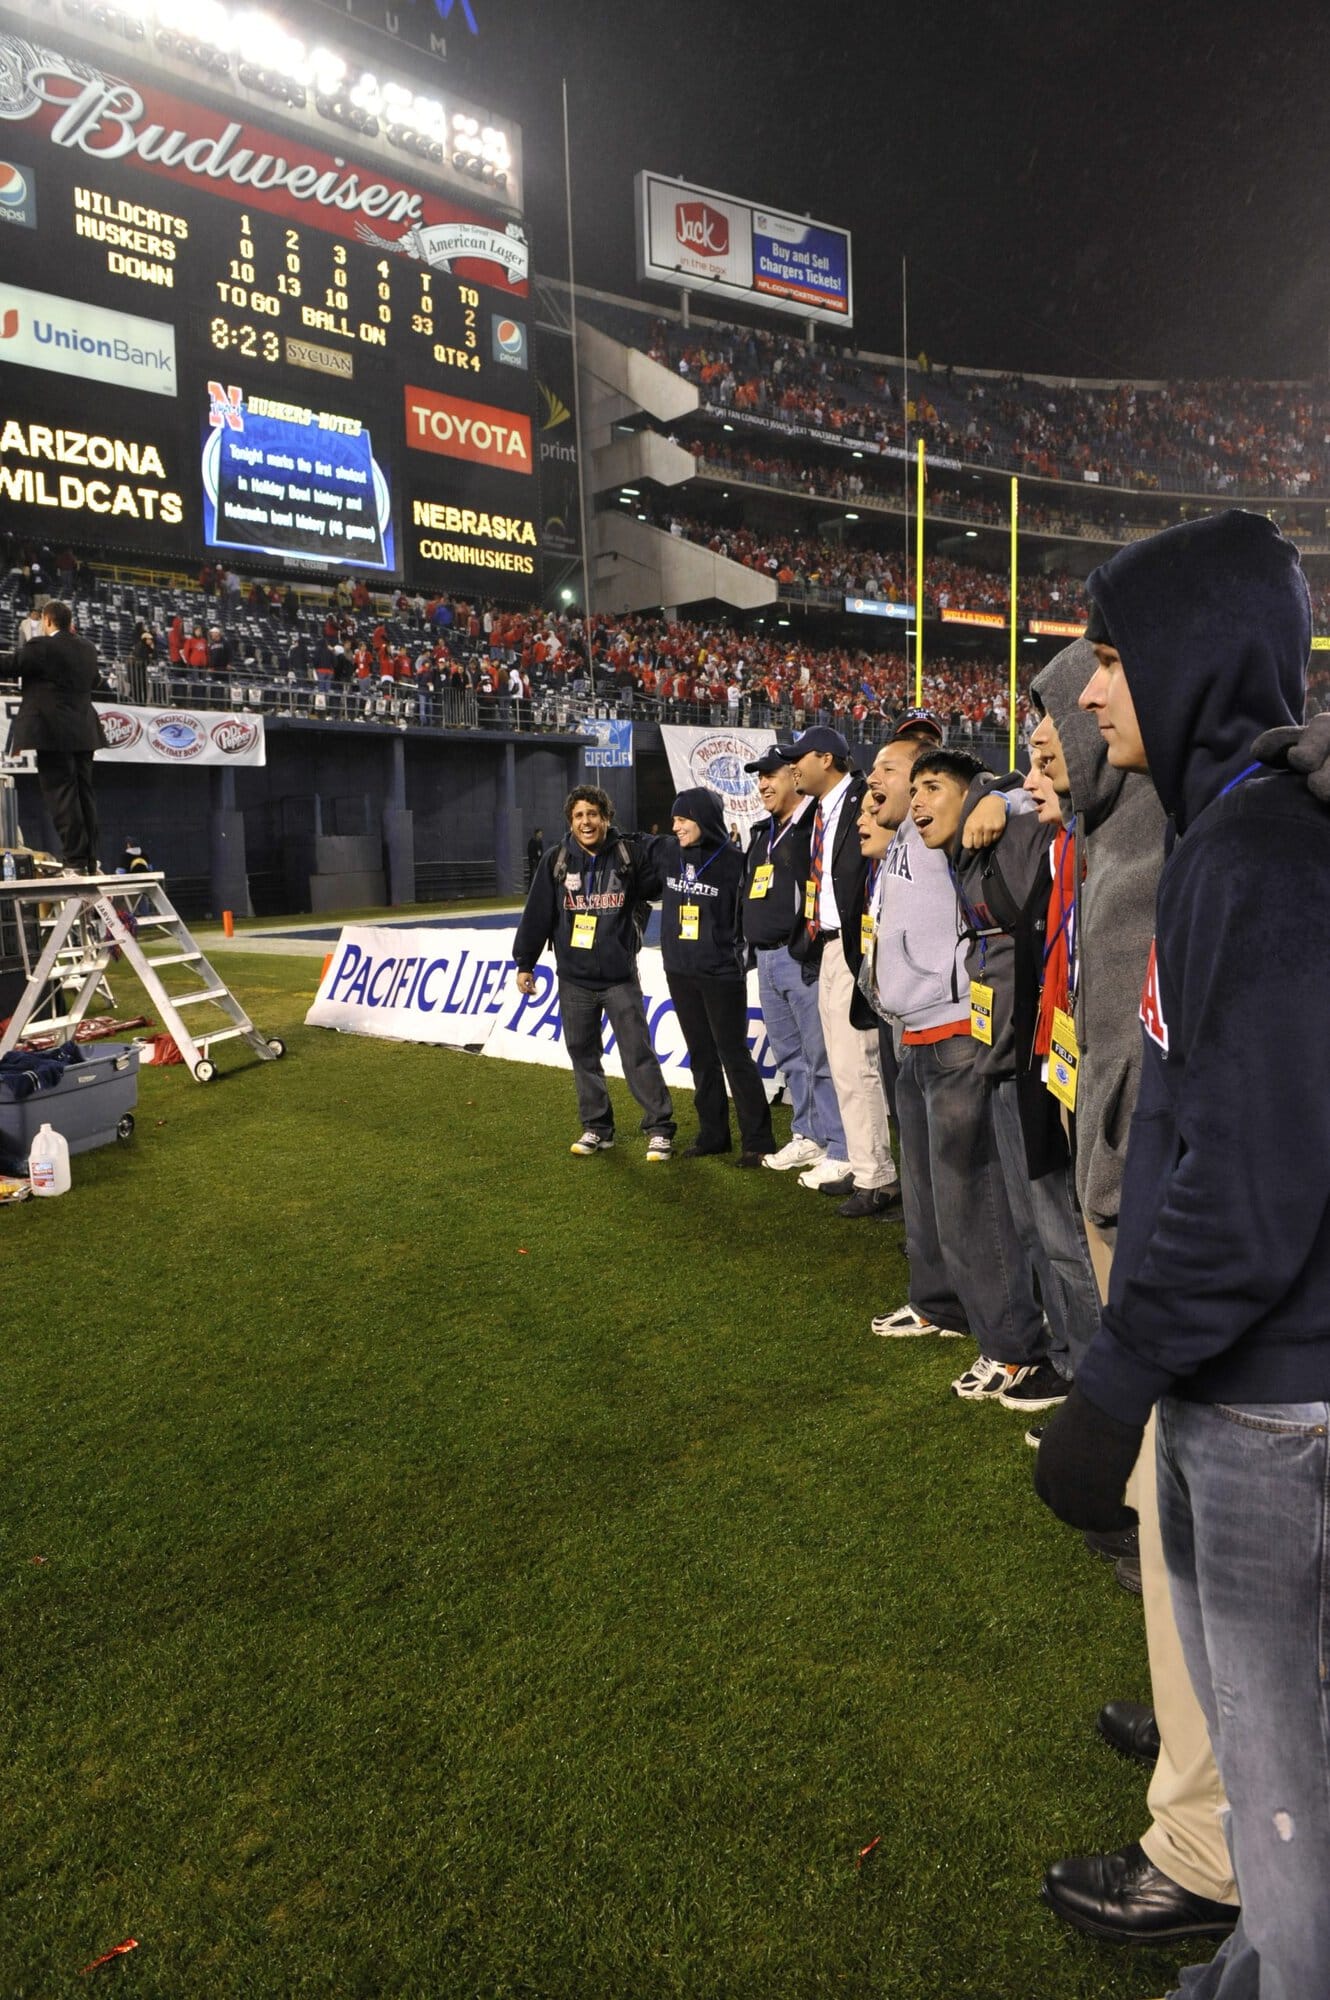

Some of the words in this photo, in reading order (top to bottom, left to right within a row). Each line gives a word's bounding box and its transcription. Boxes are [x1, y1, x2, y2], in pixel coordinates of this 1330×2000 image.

[27, 67, 422, 222] Budweiser
[429, 234, 486, 255] American
[490, 240, 525, 265] Lager
[677, 207, 728, 252] Jack
[74, 187, 188, 239] WILDCATS
[240, 239, 254, 259] 0
[286, 253, 300, 273] 0
[334, 269, 347, 287] 0
[378, 282, 390, 300] 0
[421, 296, 433, 313] 0
[465, 310, 476, 327] 2
[241, 214, 251, 235] 1
[285, 229, 299, 250] 2
[333, 245, 346, 265] 3
[377, 260, 390, 278] 4
[420, 273, 432, 291] T
[458, 285, 479, 307] TO
[760, 256, 803, 280] Chargers
[805, 268, 841, 290] Tickets!
[772, 242, 790, 262] Buy
[792, 251, 810, 265] and
[812, 254, 829, 270] Sell
[76, 214, 176, 260] HUSKERS
[229, 260, 254, 283] 10
[277, 274, 301, 297] 13
[326, 288, 348, 310] 10
[379, 305, 391, 323] 0
[412, 314, 433, 335] 33
[465, 331, 476, 348] 3
[108, 251, 174, 288] DOWN
[217, 282, 247, 308] TO
[251, 292, 280, 317] GO
[302, 306, 355, 338] BALL
[360, 323, 386, 346] ON
[433, 344, 468, 369] QTR
[470, 355, 481, 372] 4
[33, 320, 172, 371] UnionBank
[211, 318, 279, 361] 8:23
[288, 344, 351, 371] SYCUAN
[0, 420, 166, 478] ARIZONA
[412, 406, 527, 459] TOYOTA
[229, 443, 263, 466] Tonight
[297, 457, 312, 473] the
[0, 466, 183, 523] WILDCATS
[413, 500, 537, 546] NEBRASKA
[419, 539, 534, 574] CORNHUSKERS
[107, 717, 123, 730] Dr
[326, 944, 449, 1012] PACIFIC
[973, 1004, 988, 1015] FIELD
[1055, 1044, 1073, 1064] FIELD
